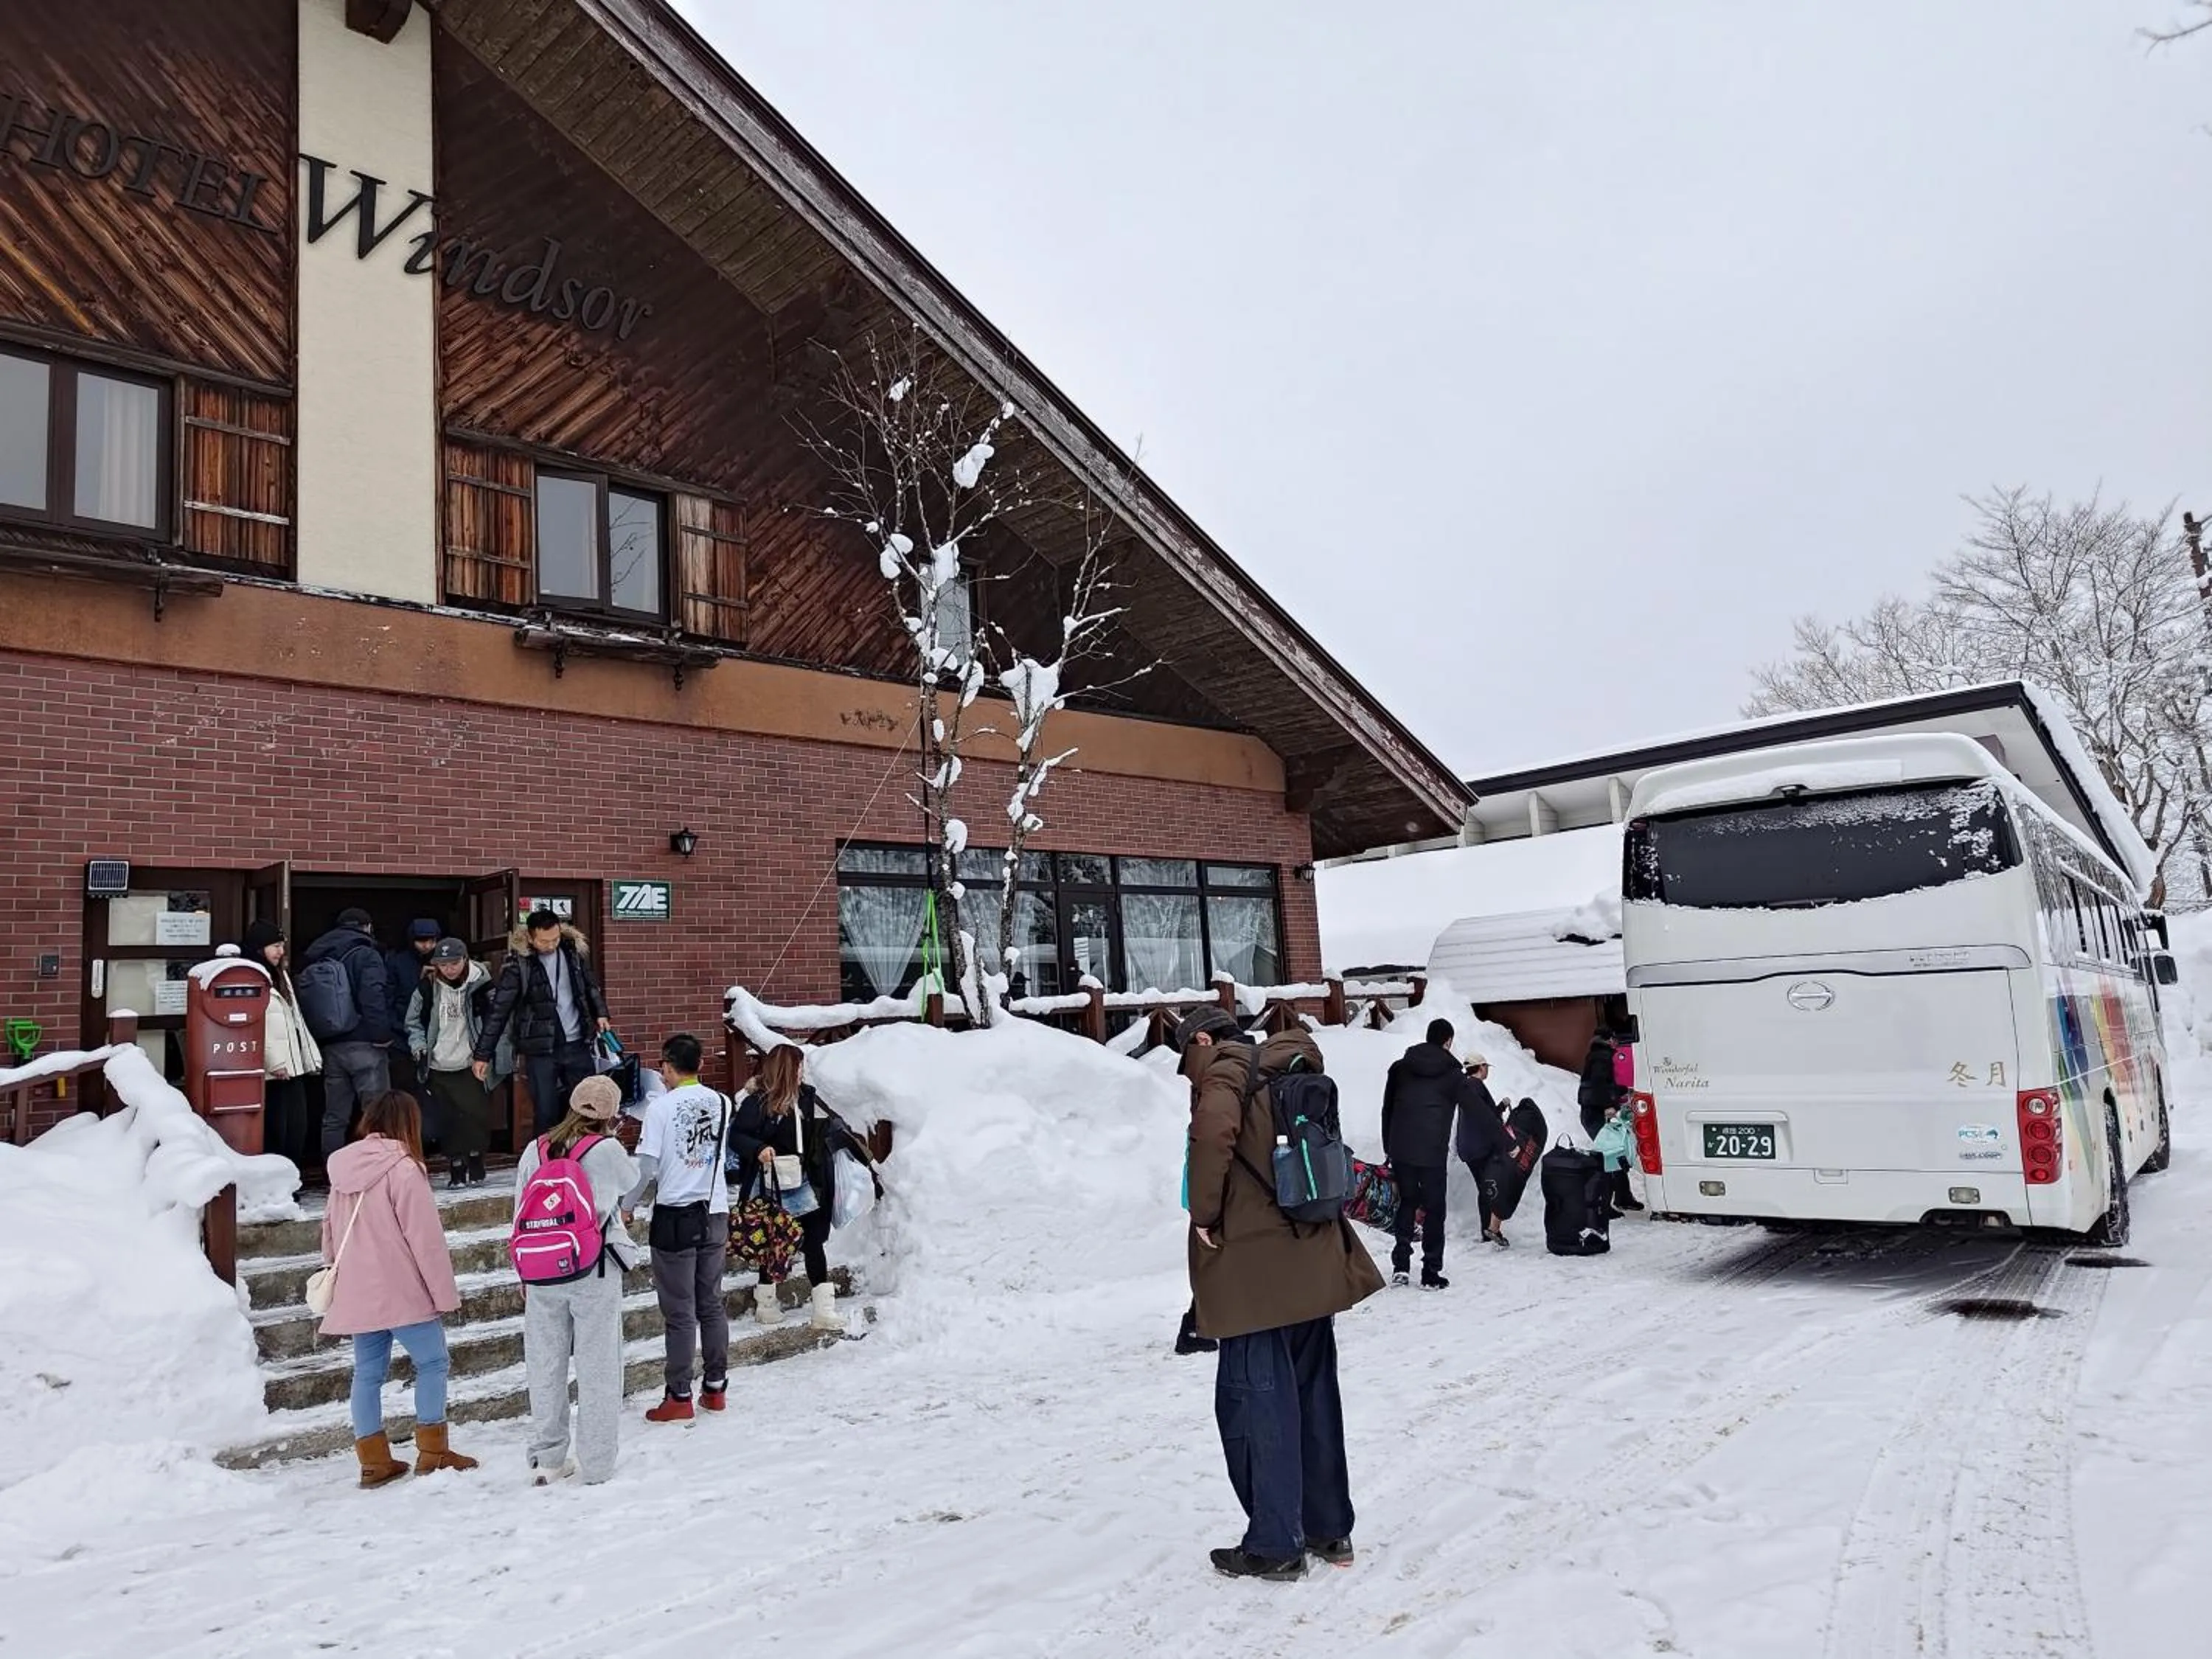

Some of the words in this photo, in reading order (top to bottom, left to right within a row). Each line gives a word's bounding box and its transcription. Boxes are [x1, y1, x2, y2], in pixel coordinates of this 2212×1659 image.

[0, 94, 279, 237] HOTEL
[298, 153, 653, 342] Windsor
[213, 1040, 257, 1054] POST
[1664, 1077, 1709, 1089] Narita
[1947, 1061, 2006, 1088] 冬月
[1716, 1135, 1772, 1155] 20-29
